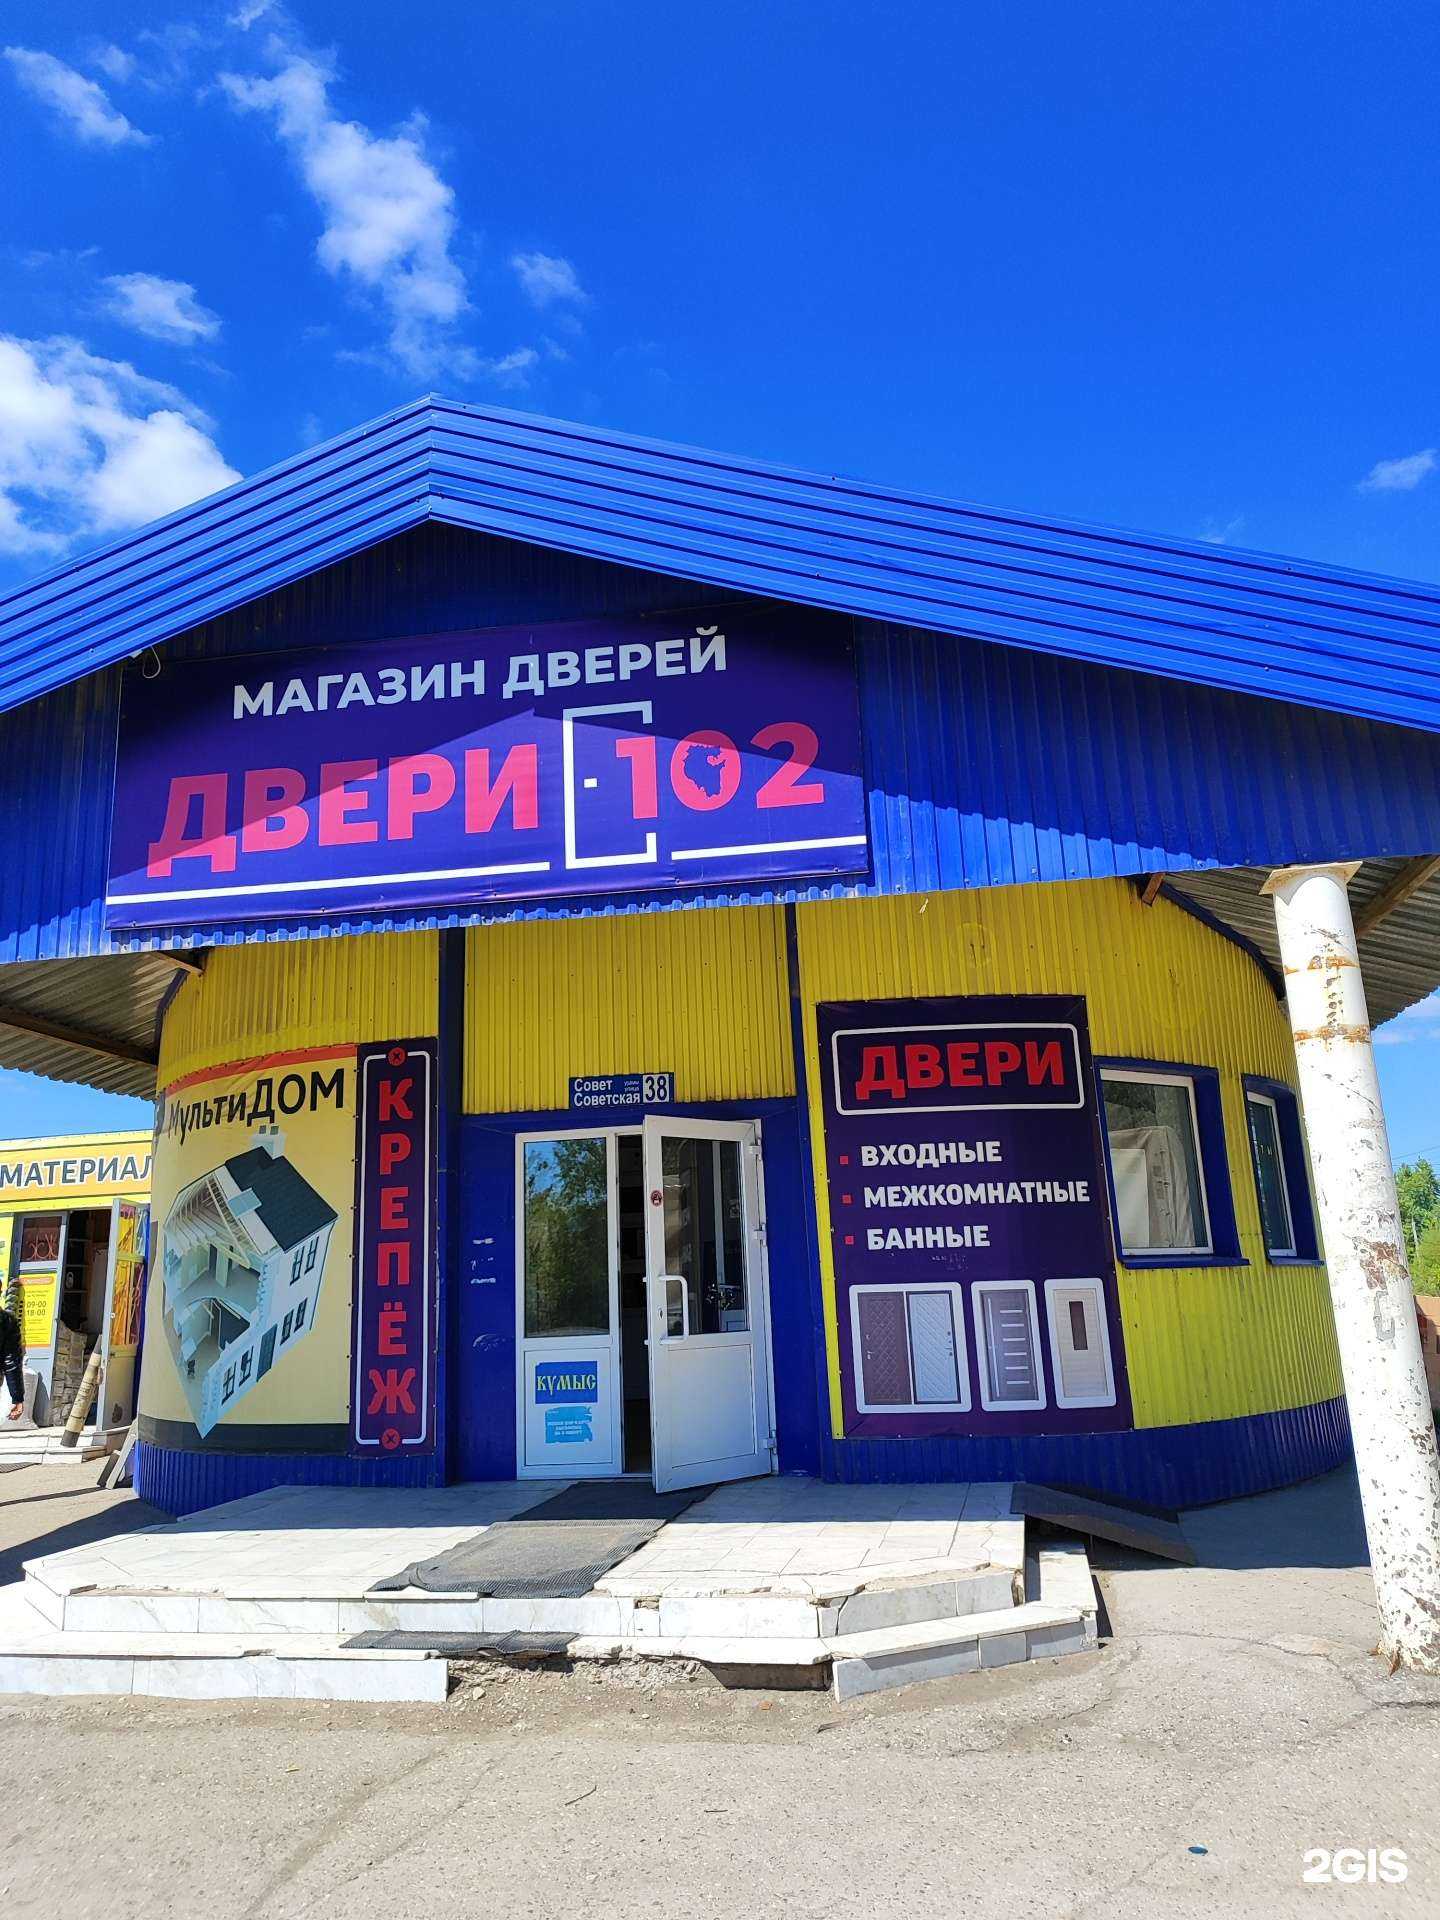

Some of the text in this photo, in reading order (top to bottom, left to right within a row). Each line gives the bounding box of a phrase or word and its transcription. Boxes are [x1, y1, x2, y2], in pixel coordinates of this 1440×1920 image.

[233, 625, 727, 720] МАГАЗИН ДВЕРЕЙ
[147, 721, 825, 878] ДВЕРИ 102
[574, 1078, 613, 1091] Совет
[855, 1041, 1065, 1100] ДВЕРИ
[574, 1092, 640, 1106] Советская
[645, 1075, 668, 1101] 38
[169, 1068, 344, 1146] МультиДОМ
[861, 1141, 1002, 1168] ВХОДНЫЕ
[863, 1181, 1090, 1209] МЕЖКОМНАТНЫЕ
[367, 1080, 416, 1415] КРЕПЁЖ
[867, 1225, 990, 1251] БАННЫЕ
